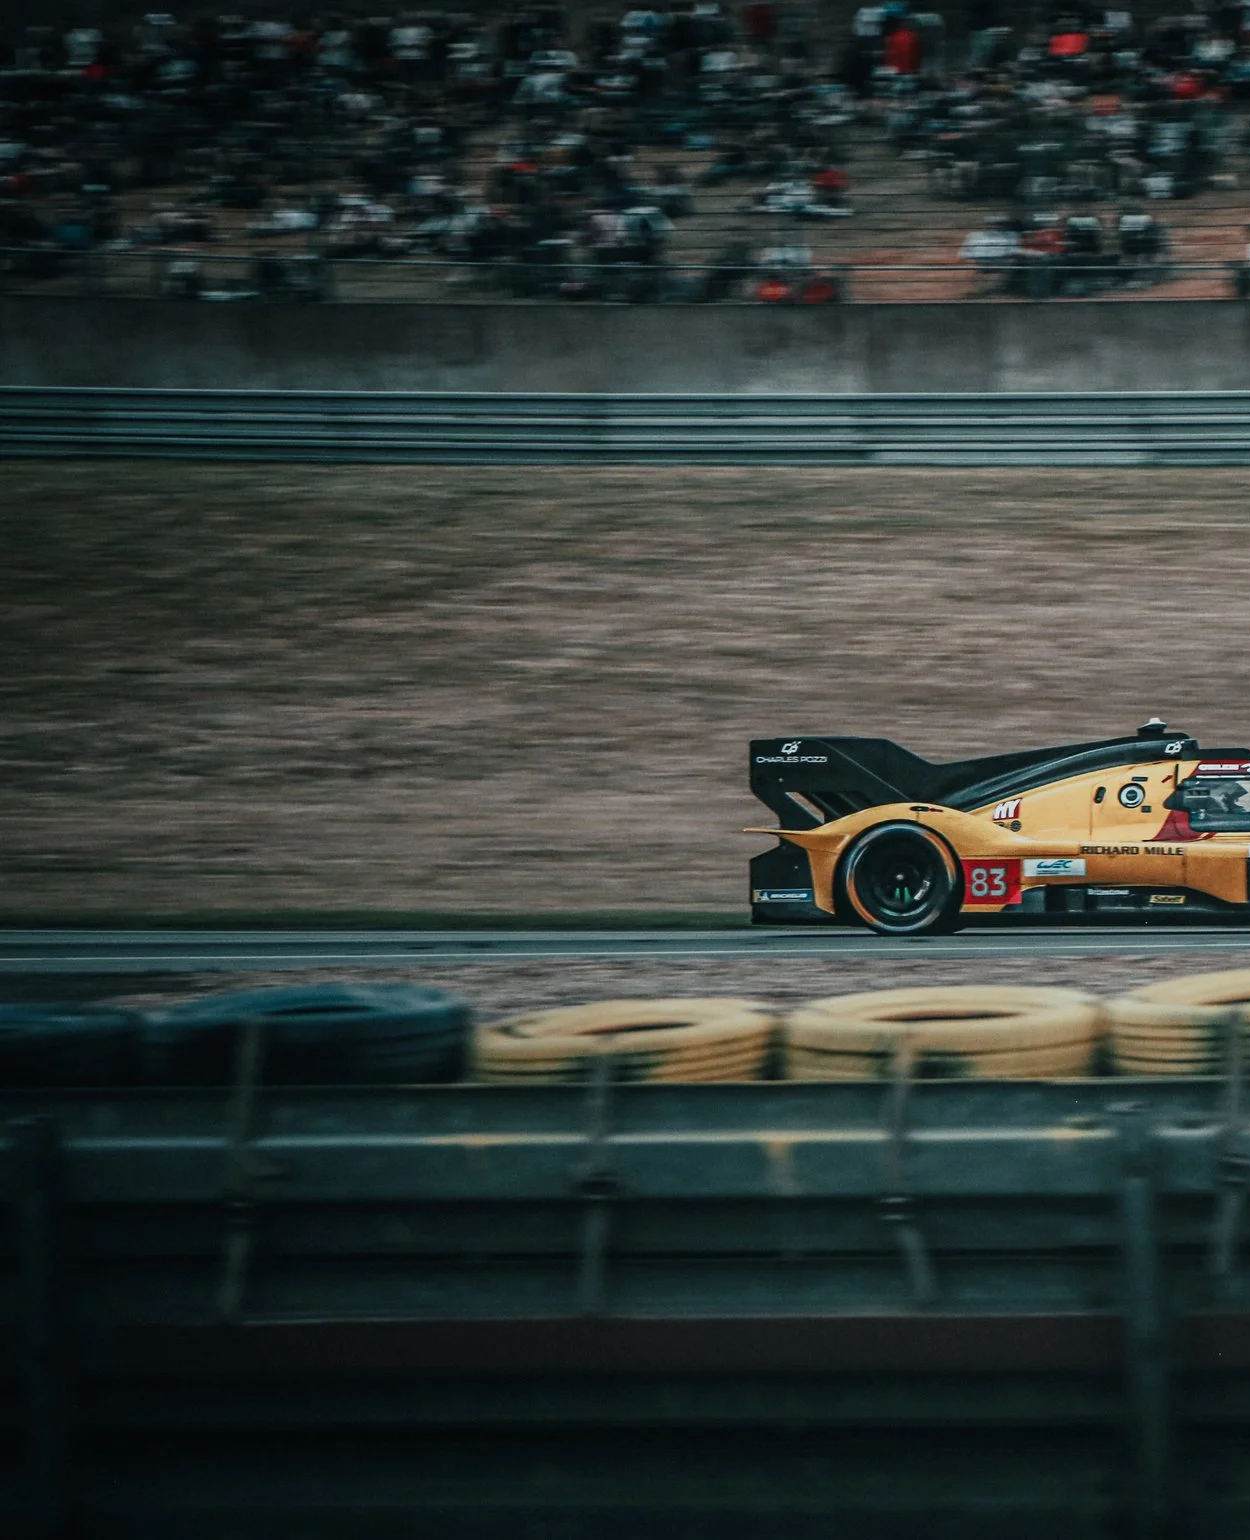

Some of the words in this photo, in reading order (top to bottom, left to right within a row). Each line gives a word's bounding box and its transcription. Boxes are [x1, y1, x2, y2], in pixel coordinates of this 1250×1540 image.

[1080, 845, 1139, 855] RICHARD
[1144, 846, 1184, 856] MILLE
[1036, 860, 1073, 869] WEC
[971, 868, 1007, 897] 83
